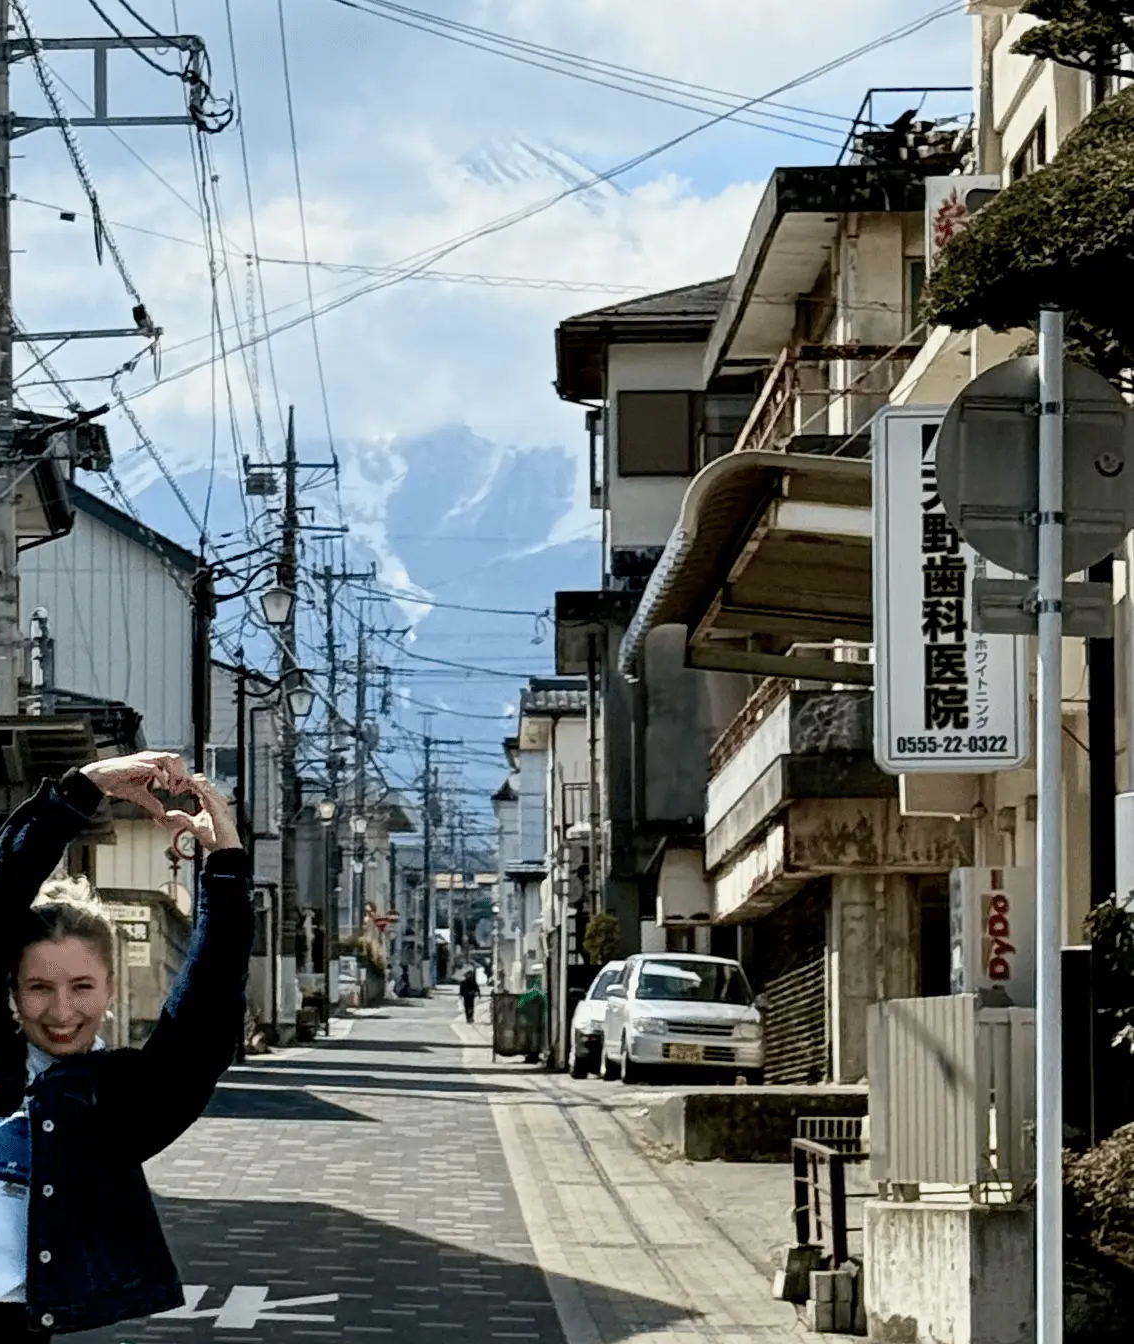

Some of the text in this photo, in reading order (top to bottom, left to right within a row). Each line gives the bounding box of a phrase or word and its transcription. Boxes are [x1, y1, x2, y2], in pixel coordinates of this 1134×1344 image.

[974, 639, 989, 730] ホワイトニング
[896, 735, 1008, 754] 0555-22-0322
[988, 895, 1016, 981] DyDo
